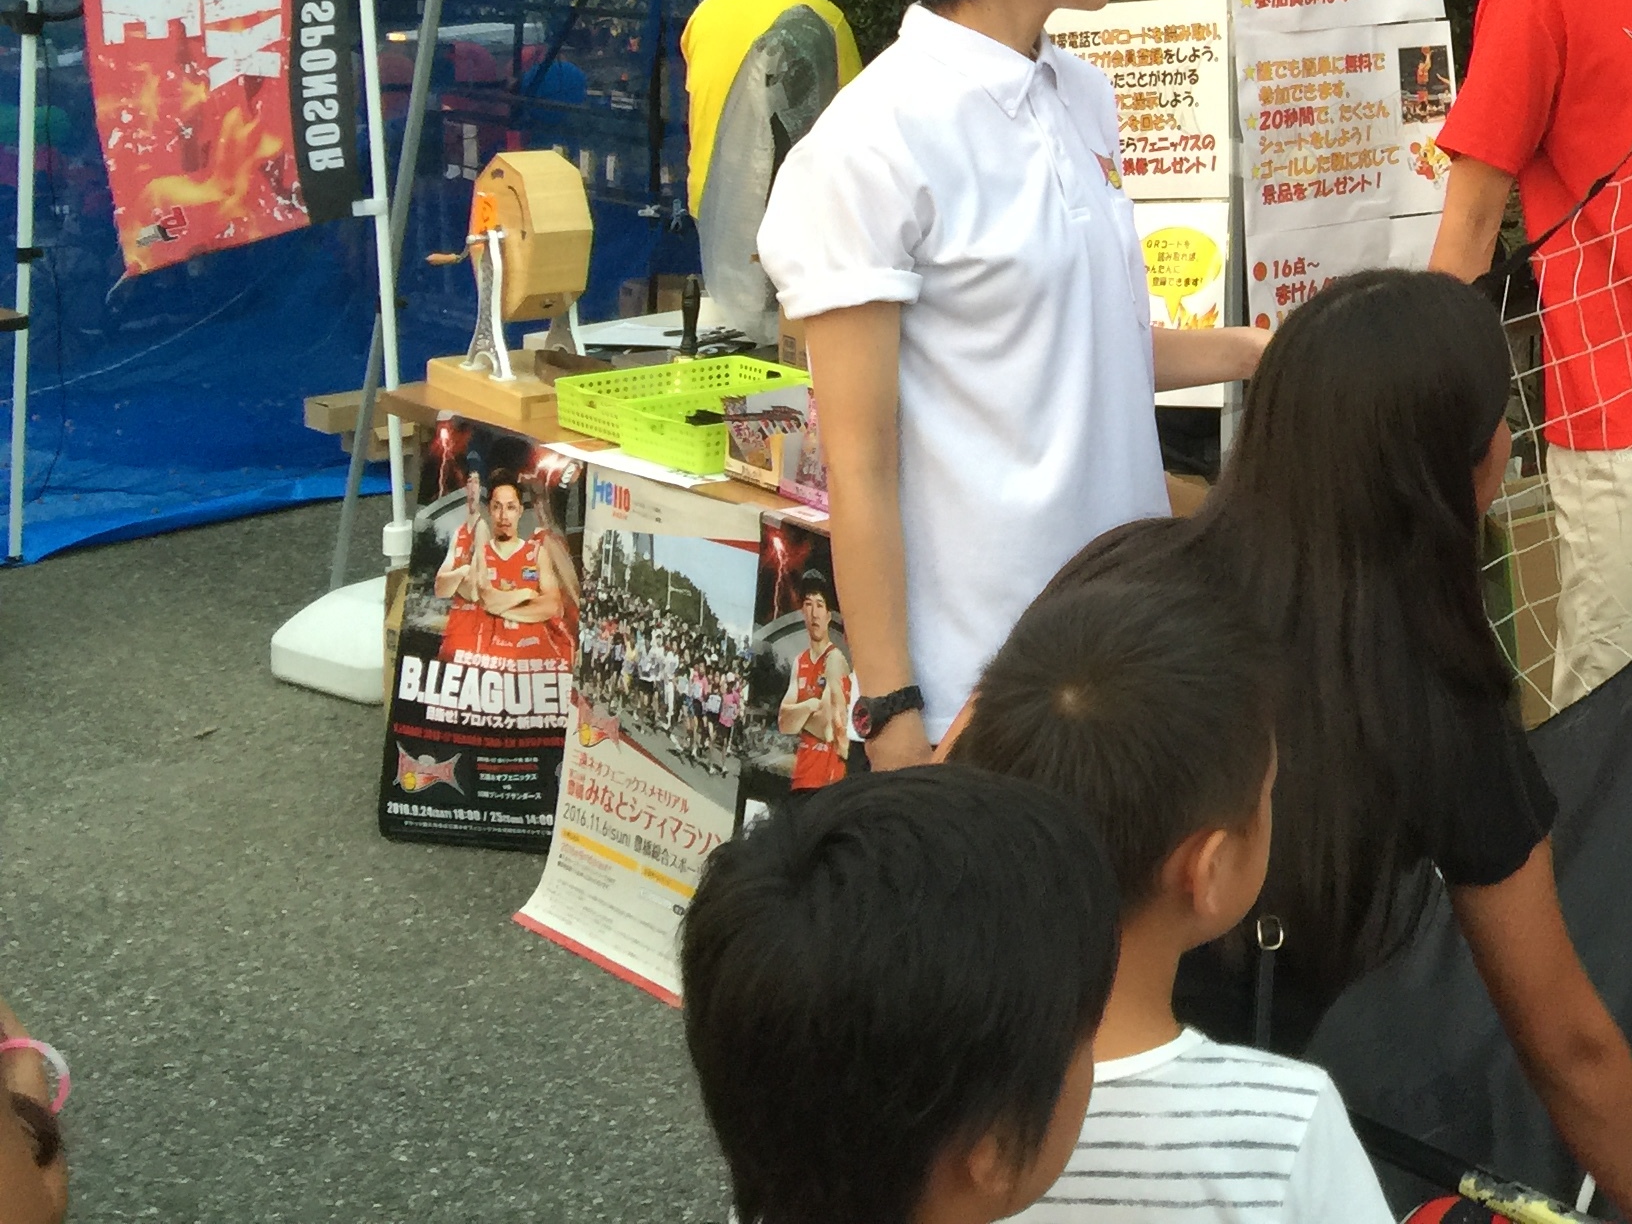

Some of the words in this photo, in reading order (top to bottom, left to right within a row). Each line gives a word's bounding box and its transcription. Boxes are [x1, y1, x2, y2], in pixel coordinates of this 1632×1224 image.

[1110, 68, 1200, 89] たことがわかる
[1256, 52, 1387, 82] 誰でも簡単に無料で
[1258, 79, 1351, 106] 参加できます。
[1259, 100, 1391, 131] 20秒間で、たくさん
[1259, 125, 1372, 155] シュートをしよう！
[1260, 146, 1401, 180] ゴールした数に応じて
[1262, 171, 1382, 206] 景品をプレゼント！
